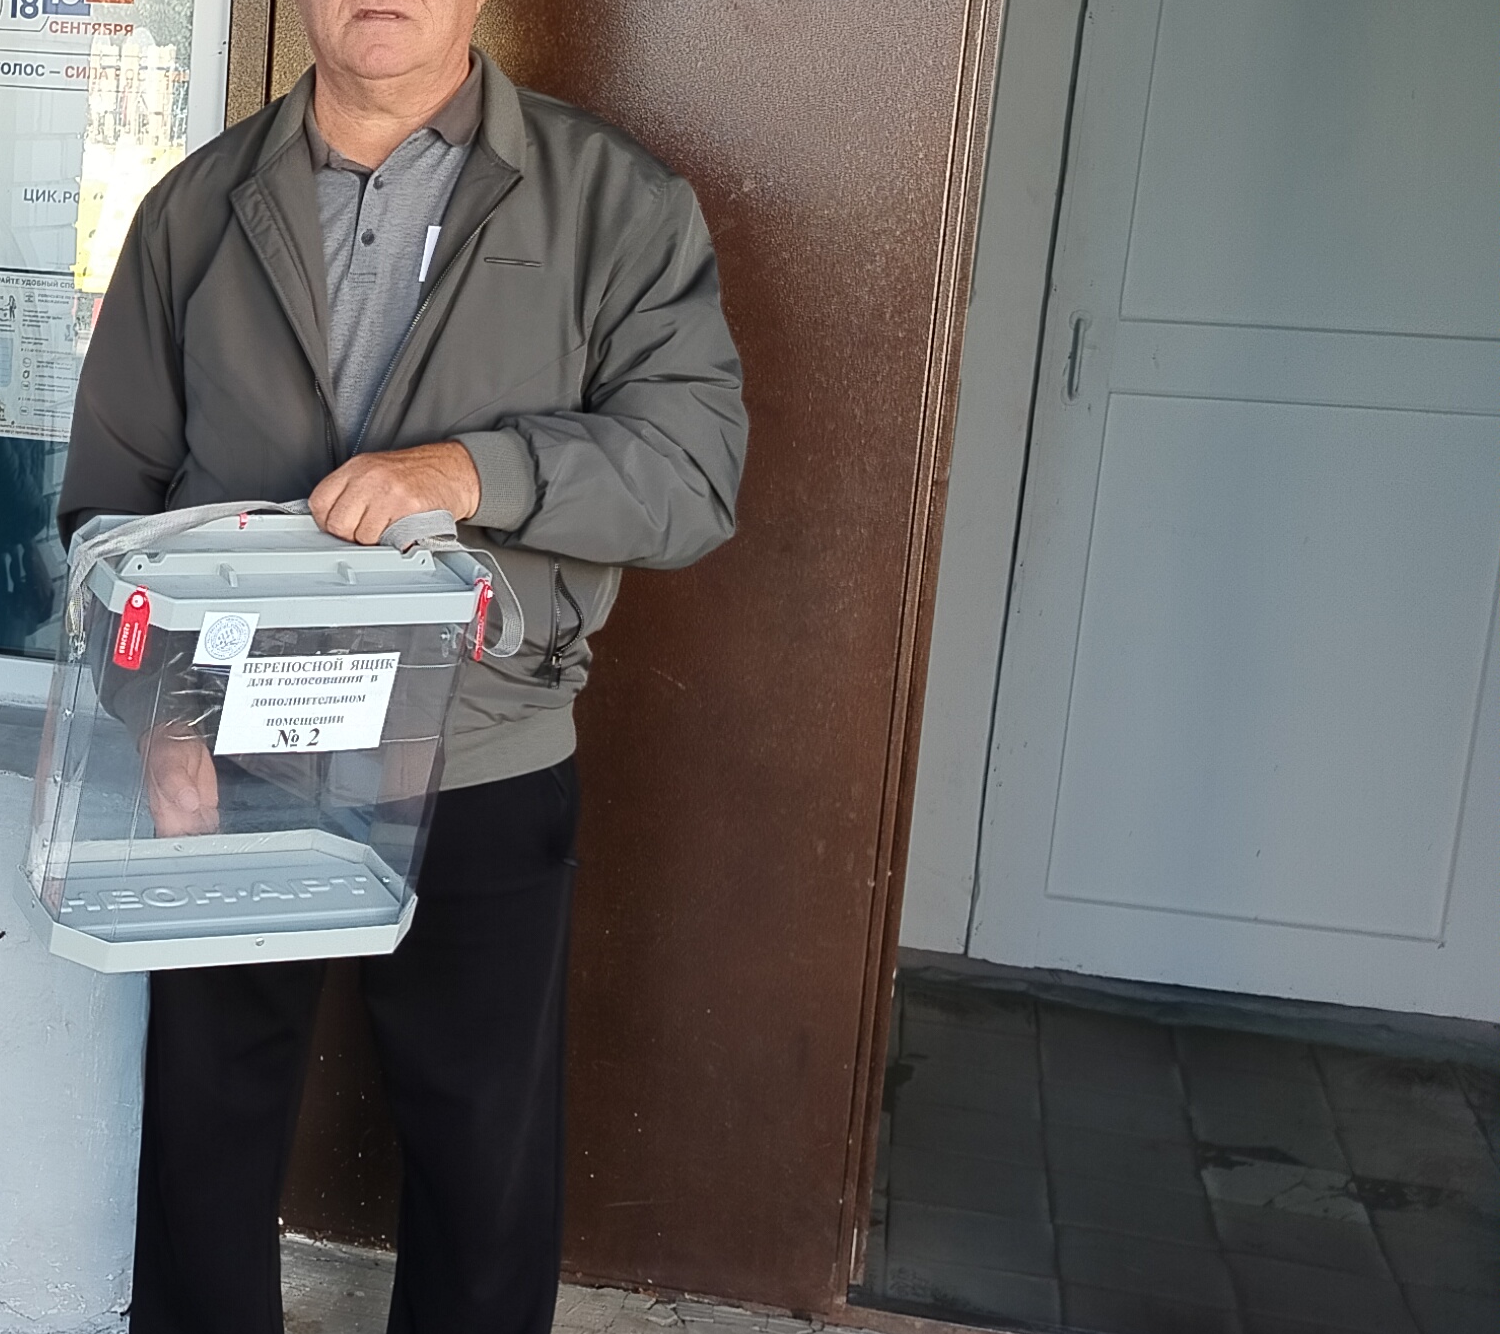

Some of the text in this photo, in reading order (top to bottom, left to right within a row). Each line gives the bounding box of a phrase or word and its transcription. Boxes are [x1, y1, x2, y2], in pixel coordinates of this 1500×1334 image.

[49, 20, 134, 36] СЕНТЯБРЯ
[65, 65, 109, 80] СИЛА
[21, 278, 59, 287] УДОБНЫЙ
[242, 658, 396, 674] ПЕРЕНОСНОЙ ЯЩИК
[247, 678, 273, 687] для
[251, 694, 366, 707] дополнительном
[266, 716, 345, 727] помещении
[272, 728, 320, 748] № 2
